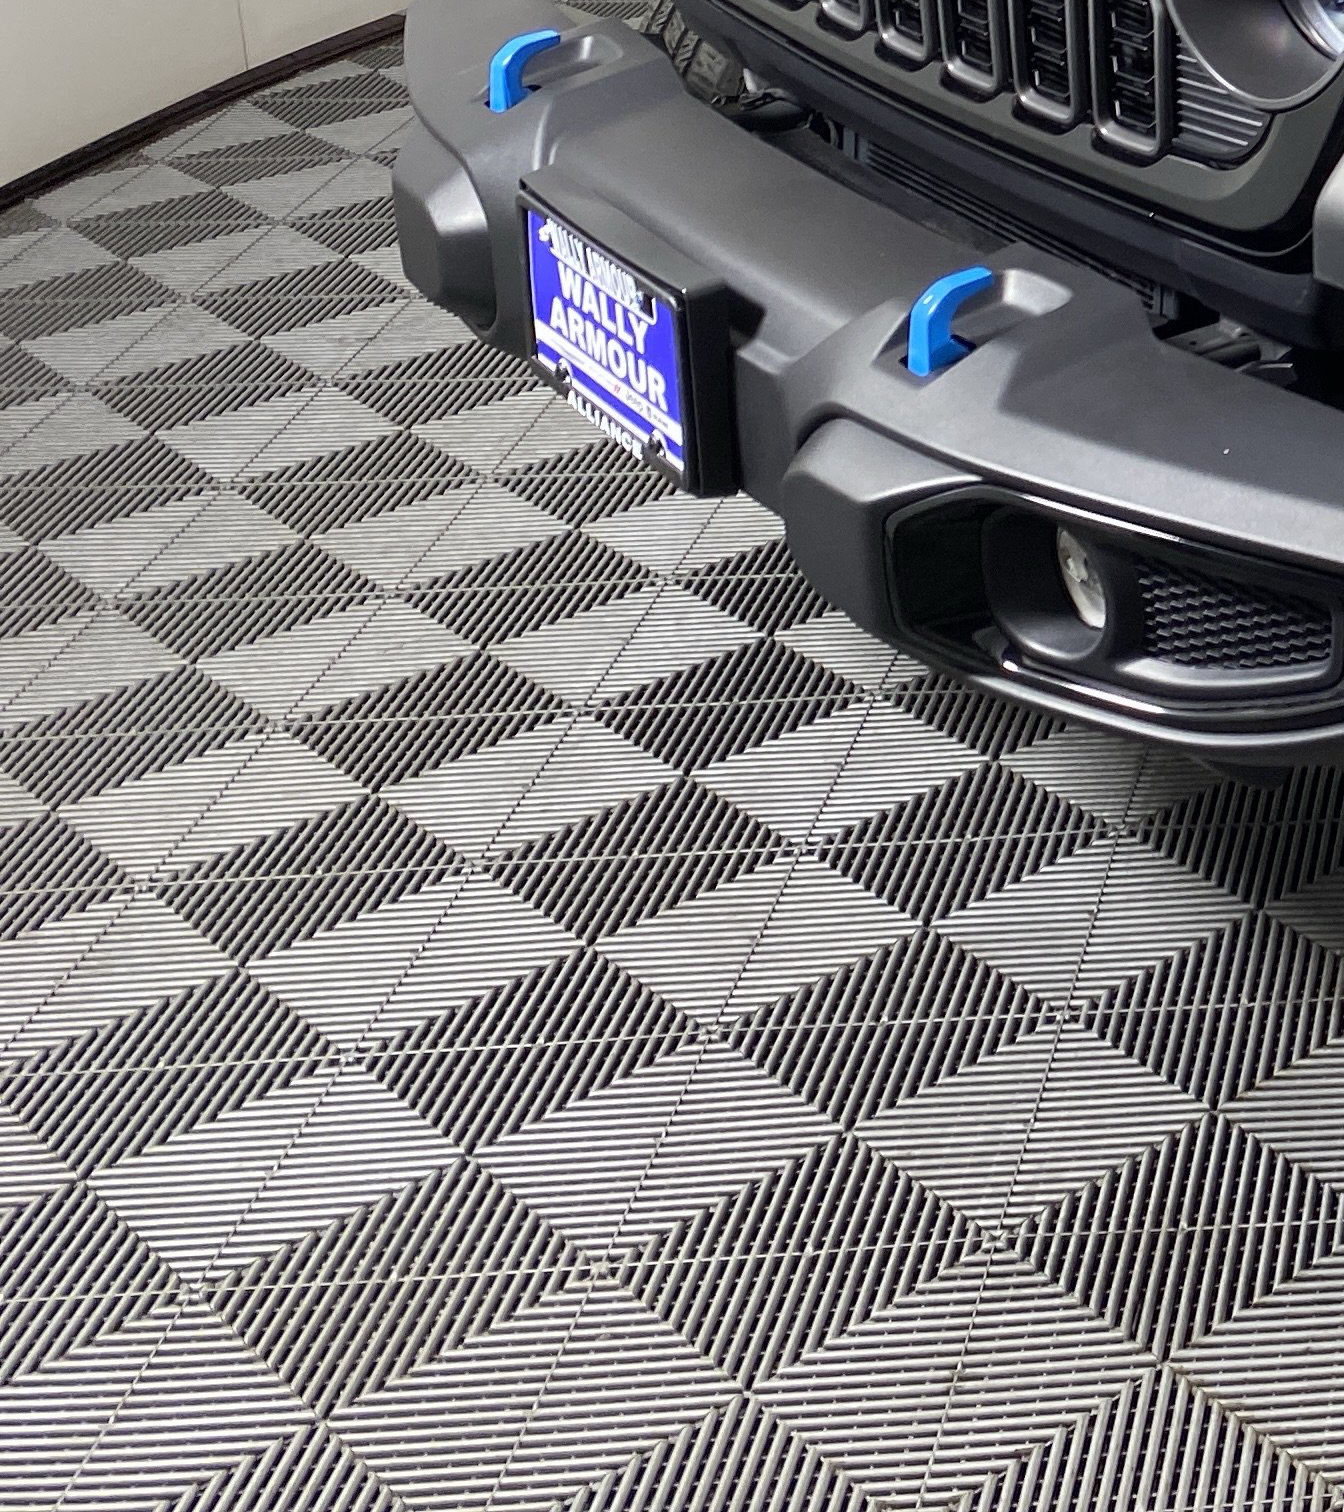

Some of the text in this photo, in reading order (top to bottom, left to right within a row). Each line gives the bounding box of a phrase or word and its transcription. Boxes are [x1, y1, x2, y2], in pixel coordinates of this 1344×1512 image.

[557, 260, 649, 354] WALLY
[549, 296, 668, 413] ARMOUR
[567, 390, 644, 461] ALLIANCE
